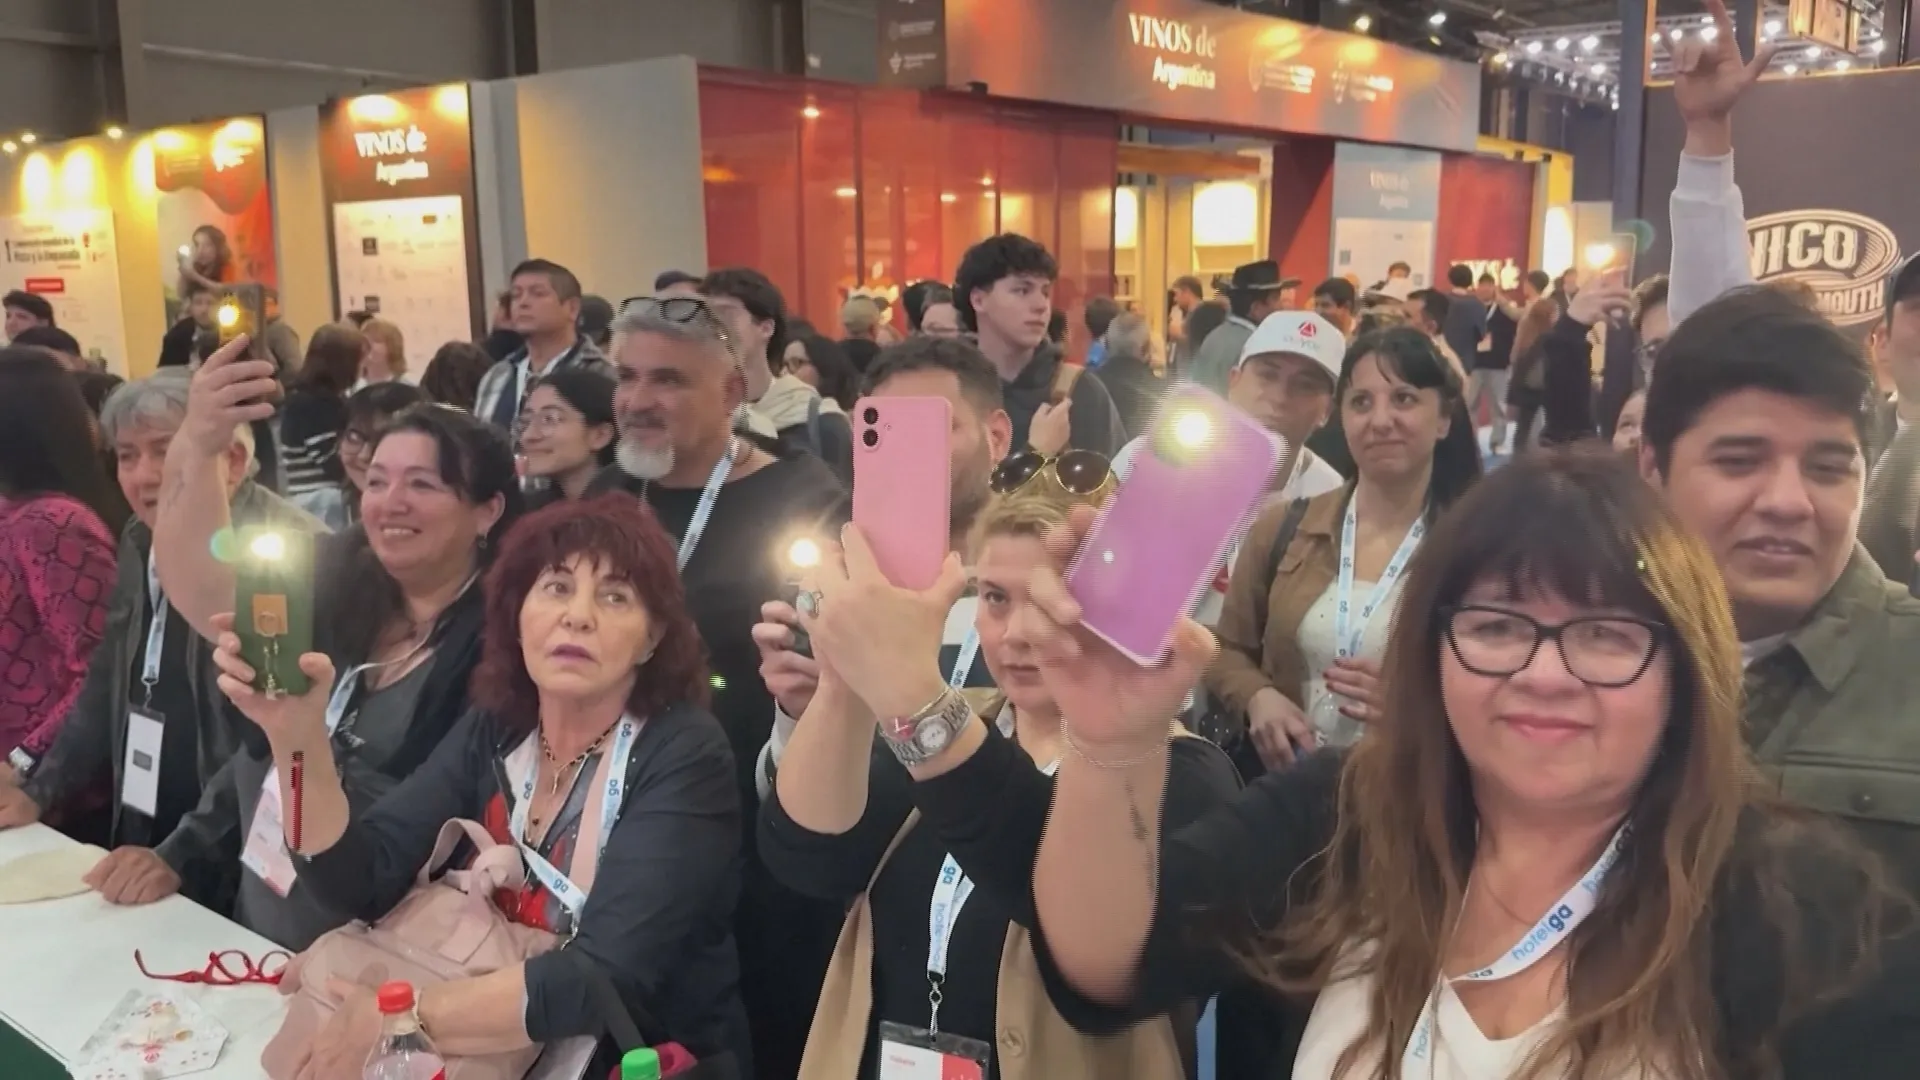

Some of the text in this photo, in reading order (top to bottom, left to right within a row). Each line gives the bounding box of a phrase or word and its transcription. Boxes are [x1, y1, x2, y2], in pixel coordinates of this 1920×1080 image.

[1129, 13, 1216, 58] VINOS de
[1153, 56, 1216, 91] Argentina
[1511, 903, 1574, 961] hotelga
